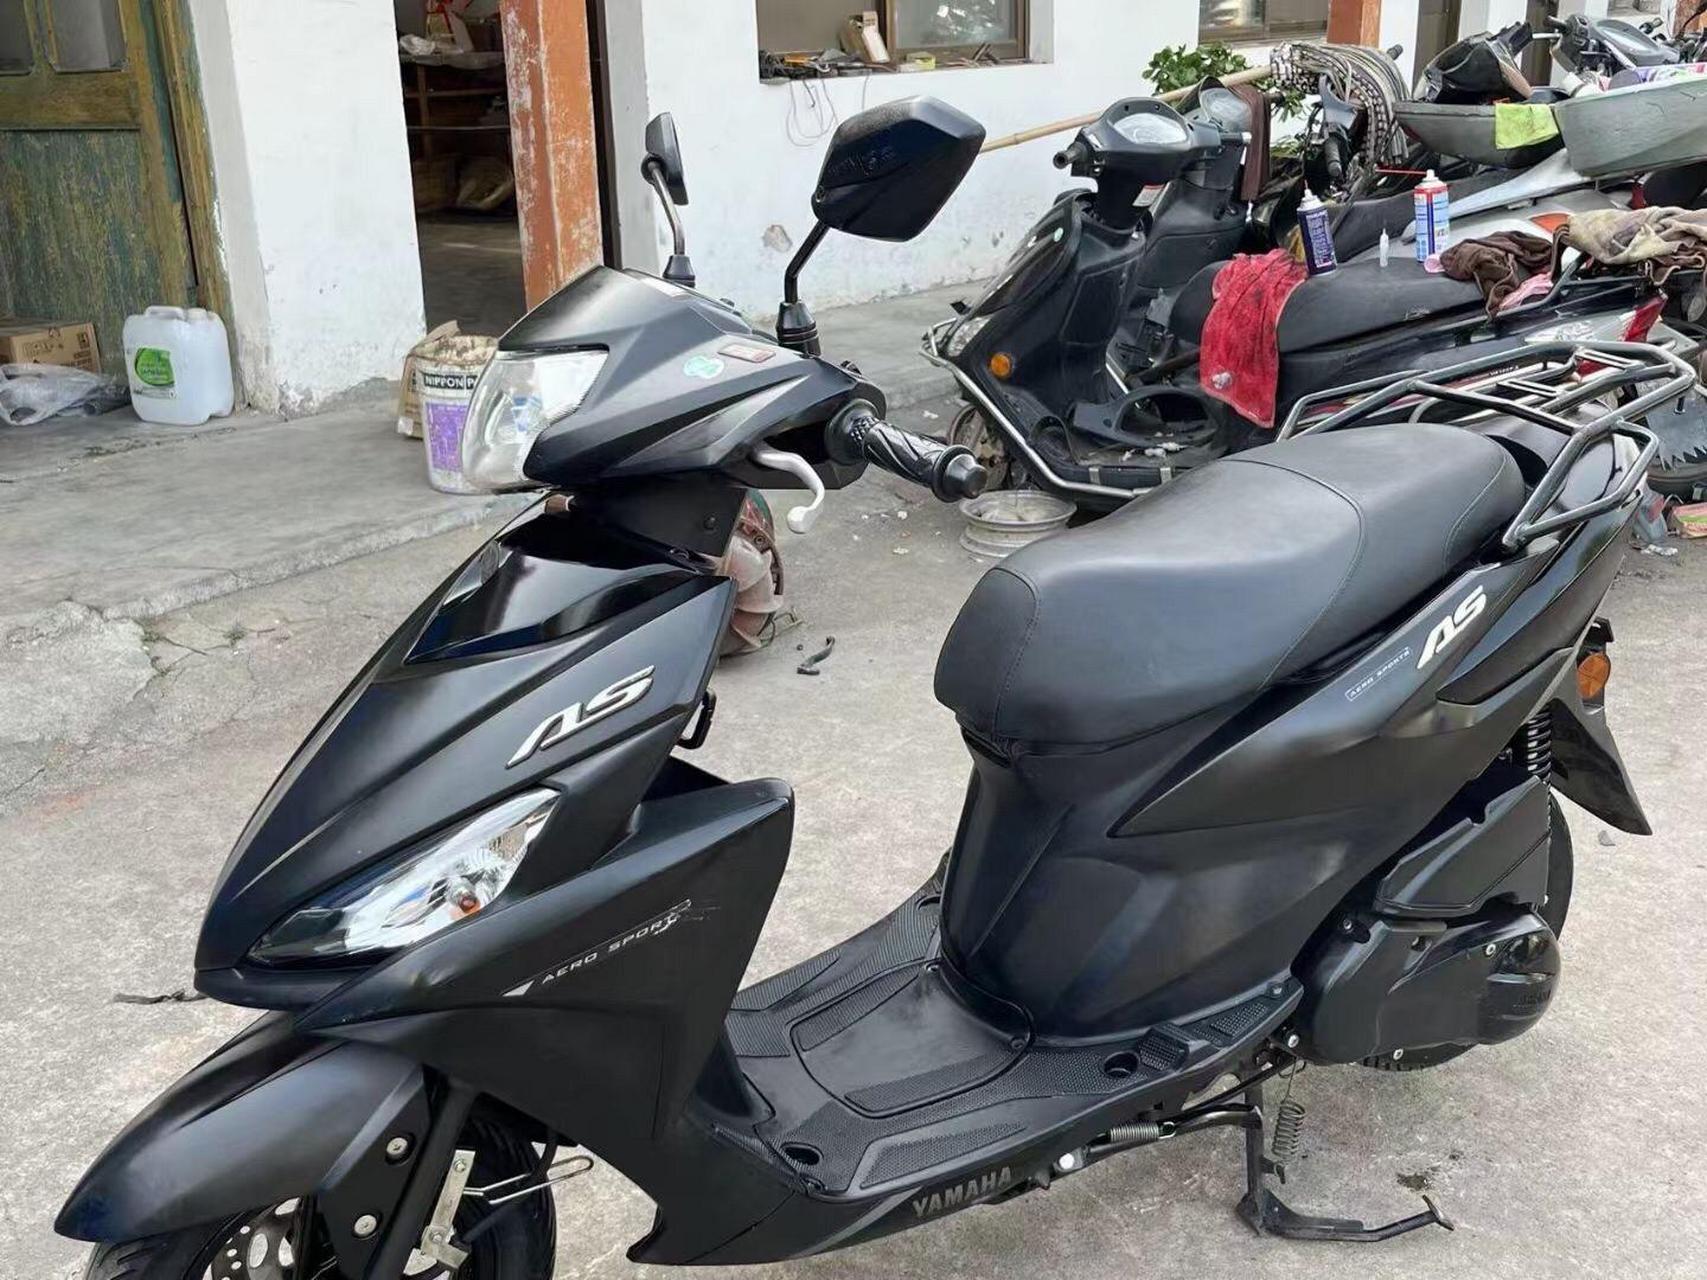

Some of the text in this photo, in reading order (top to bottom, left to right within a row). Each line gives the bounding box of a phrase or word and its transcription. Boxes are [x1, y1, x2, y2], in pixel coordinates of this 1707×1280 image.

[425, 375, 464, 388] NIPPON
[542, 952, 598, 984] AERO
[912, 1166, 1012, 1218] YAMAHA
